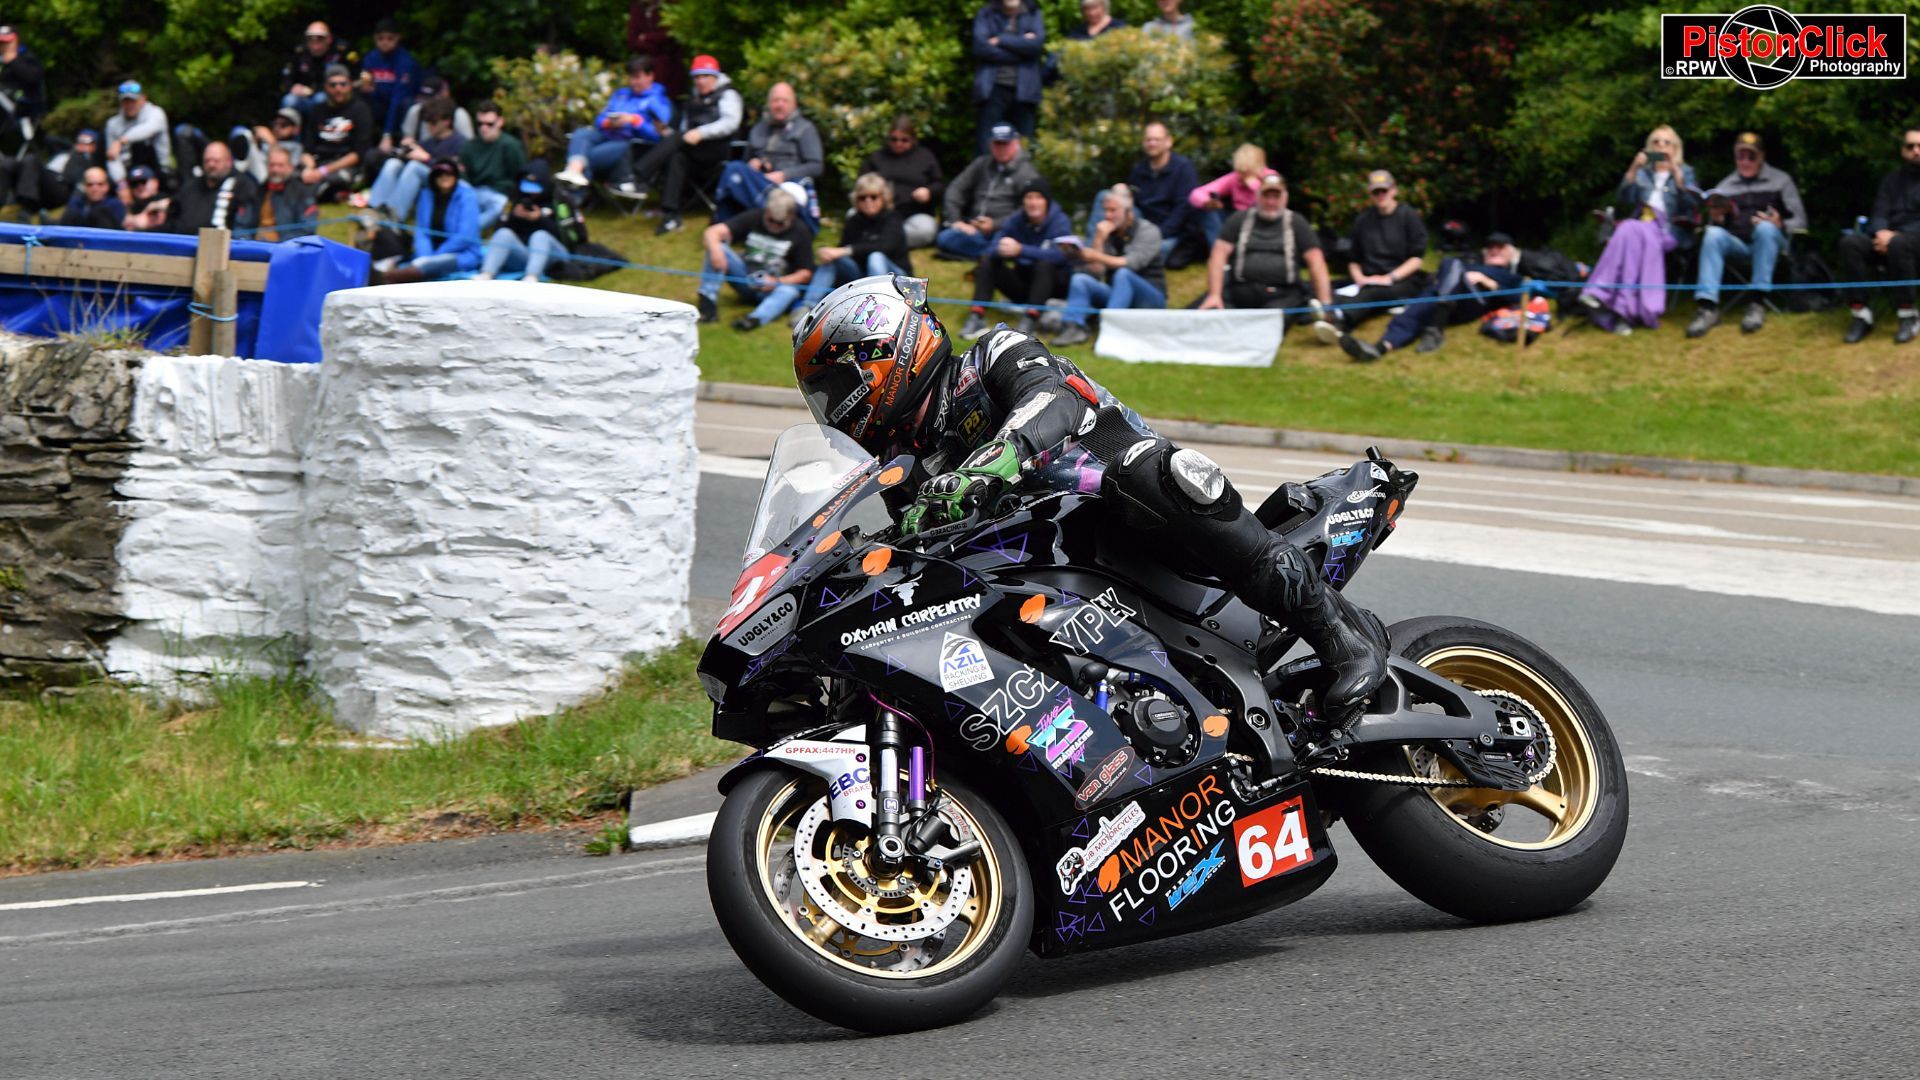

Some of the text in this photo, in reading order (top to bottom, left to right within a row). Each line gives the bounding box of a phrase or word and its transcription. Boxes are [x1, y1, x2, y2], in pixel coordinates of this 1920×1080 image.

[885, 314, 919, 407] MANOR FLOORING
[840, 594, 981, 646] OXMAN CARPENTRY
[944, 653, 984, 673] AZIL
[944, 665, 980, 681] RACKING
[948, 672, 987, 689] SHELVING
[829, 767, 871, 800] EBC
[843, 784, 872, 797] BRAKE
[1078, 779, 1102, 802] van
[1099, 750, 1129, 785] glass
[1094, 807, 1140, 853] MOTORCYCLES
[1119, 764, 1225, 875] MANOR
[1238, 808, 1310, 880] 64
[1108, 799, 1236, 923] FLOORING
